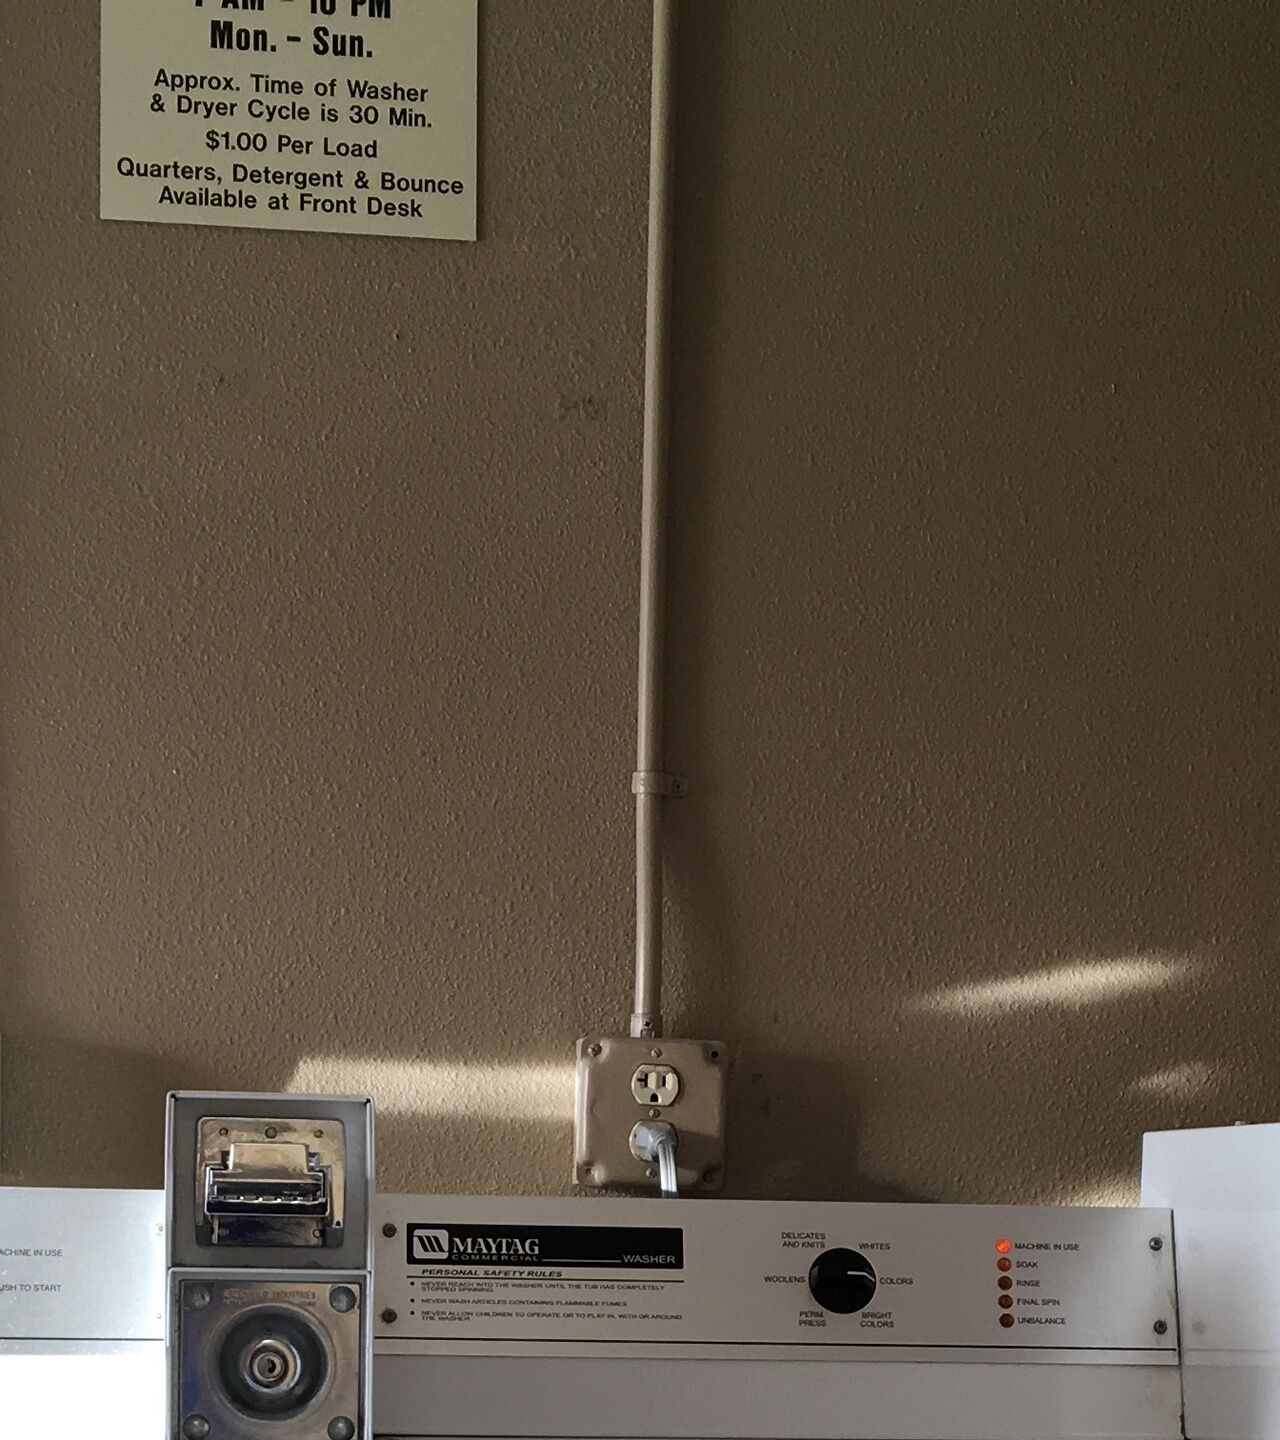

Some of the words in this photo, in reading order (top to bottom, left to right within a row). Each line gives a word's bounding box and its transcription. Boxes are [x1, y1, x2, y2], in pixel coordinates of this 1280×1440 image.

[210, 20, 277, 52] Mon.
[313, 26, 373, 58] Sun.
[153, 68, 241, 93] Approx.
[250, 73, 304, 96] Time
[313, 78, 337, 97] of
[347, 78, 428, 103] Washer
[149, 93, 166, 113] &
[176, 95, 237, 119] Dryer
[247, 98, 311, 123] Cycle
[320, 103, 339, 123] is
[349, 105, 379, 125] 30
[389, 107, 433, 128] Min.
[205, 130, 268, 153] $1.00
[277, 134, 313, 155] Per
[323, 137, 378, 158] Load
[116, 157, 222, 185] Quarters,
[232, 164, 344, 189] Detergent
[353, 171, 370, 191] &
[380, 172, 464, 195] Bounce
[158, 186, 258, 209] Available
[267, 190, 289, 211] at
[299, 192, 357, 214] Front
[367, 196, 423, 218] Desk
[781, 1232, 826, 1240] DELICATES
[452, 1237, 539, 1255] MAYTAG
[801, 1241, 825, 1249] KNITS
[1014, 1242, 1051, 1250] MACHINE
[1063, 1243, 1080, 1251] USE
[33, 1248, 43, 1257] IN
[44, 1249, 63, 1257] USE
[451, 1254, 538, 1262] COMMERCIAL
[623, 1254, 676, 1264] WASHER
[483, 1269, 525, 1277] SAFETY
[879, 1277, 914, 1285] COLORS
[1016, 1279, 1040, 1287] RINSE
[19, 1284, 31, 1292] TO
[33, 1284, 62, 1292] START
[1016, 1298, 1040, 1306] FINAL
[1041, 1298, 1060, 1306] SPIN
[861, 1311, 892, 1319] BRIGHT
[799, 1319, 827, 1327] PRESS
[860, 1320, 894, 1328] COLORS
[1017, 1316, 1066, 1325] UNBALANCE
